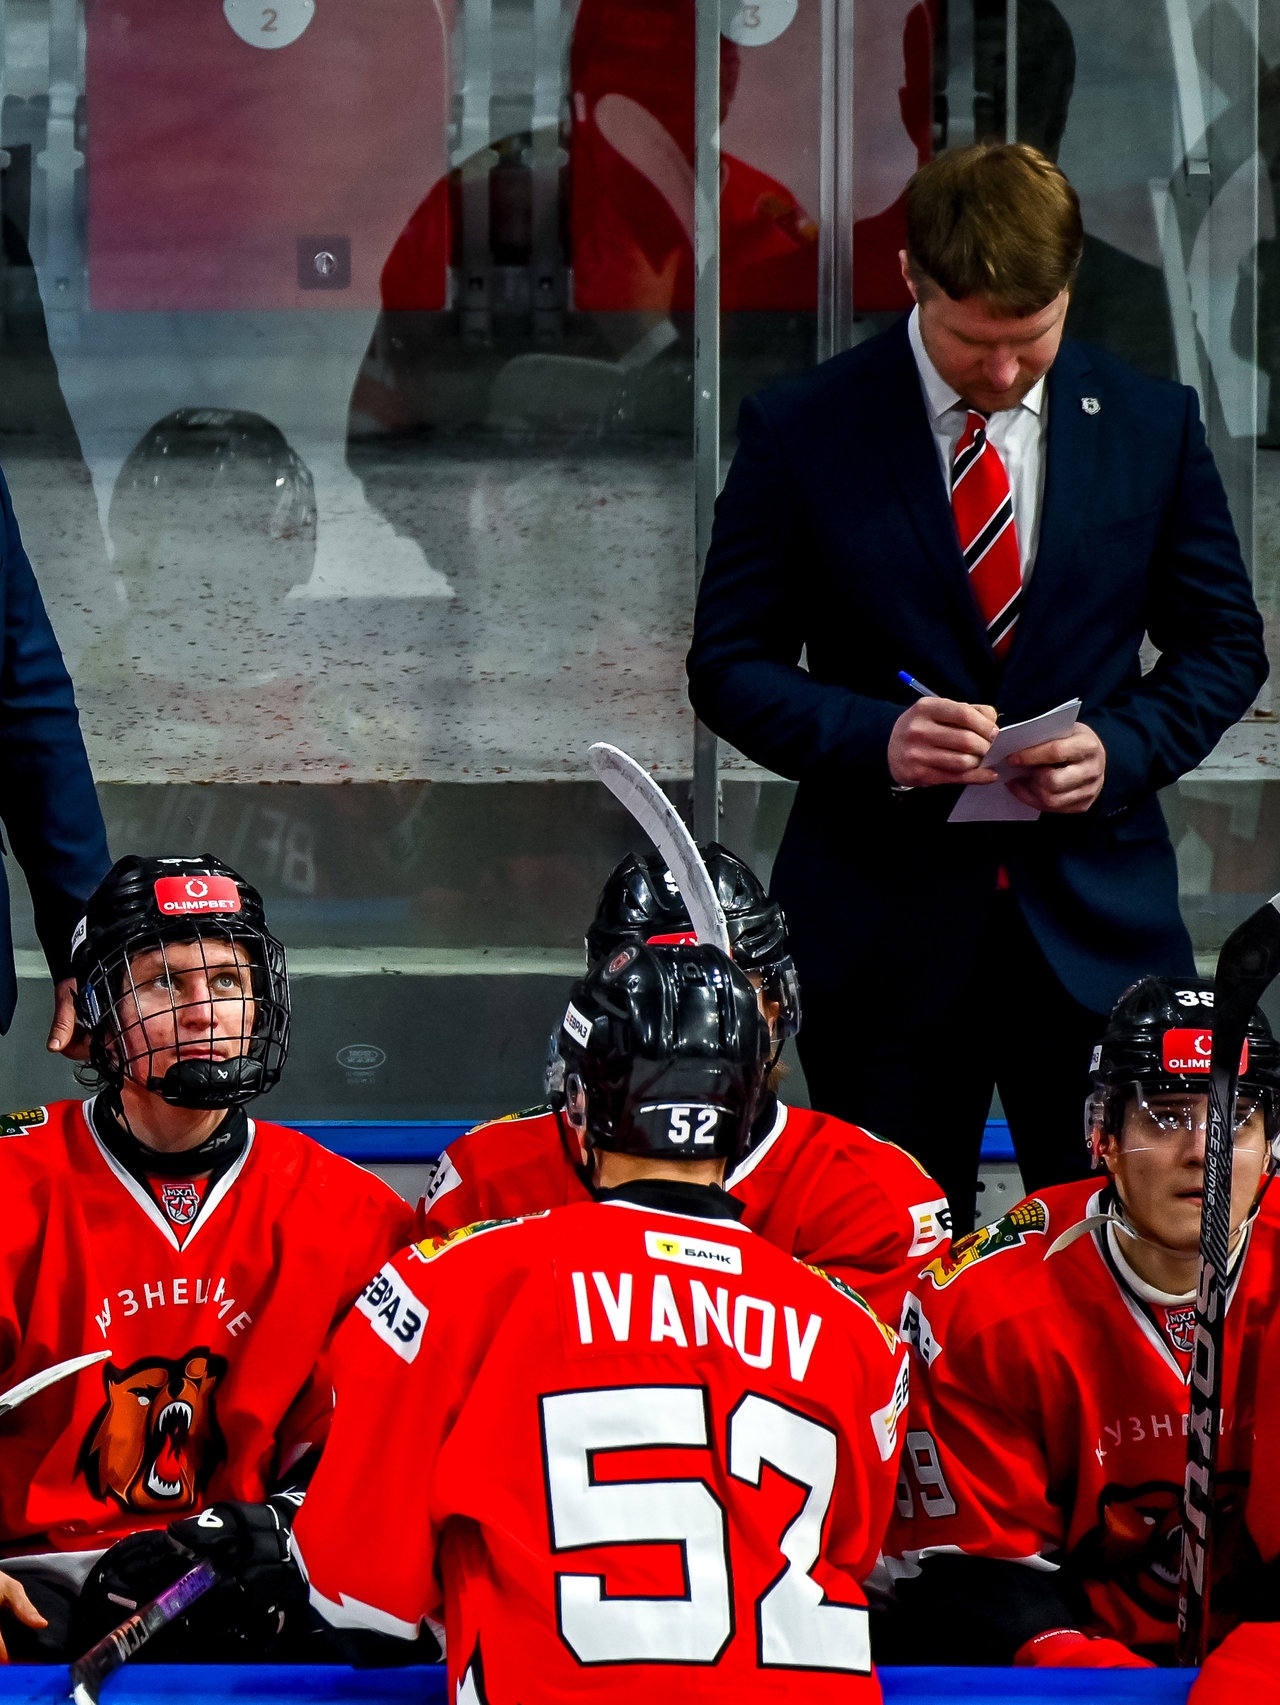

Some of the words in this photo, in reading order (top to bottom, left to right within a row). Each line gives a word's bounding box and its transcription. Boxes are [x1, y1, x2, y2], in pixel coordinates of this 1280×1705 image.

[261, 8, 278, 32] 2
[743, 5, 761, 28] 3
[163, 900, 235, 910] OLIMPBET
[569, 1013, 588, 1040] ЕВРАЗ
[1169, 1059, 1211, 1069] OLIMP
[668, 1108, 718, 1144] 52
[1210, 1107, 1222, 1153] ACE
[167, 1189, 193, 1197] МХЛ
[684, 1248, 731, 1265] БАНК
[572, 1272, 822, 1382] IVANOV
[1170, 1311, 1195, 1323] МХЛ
[538, 1383, 872, 1678] 52
[110, 1615, 151, 1662] CCM
